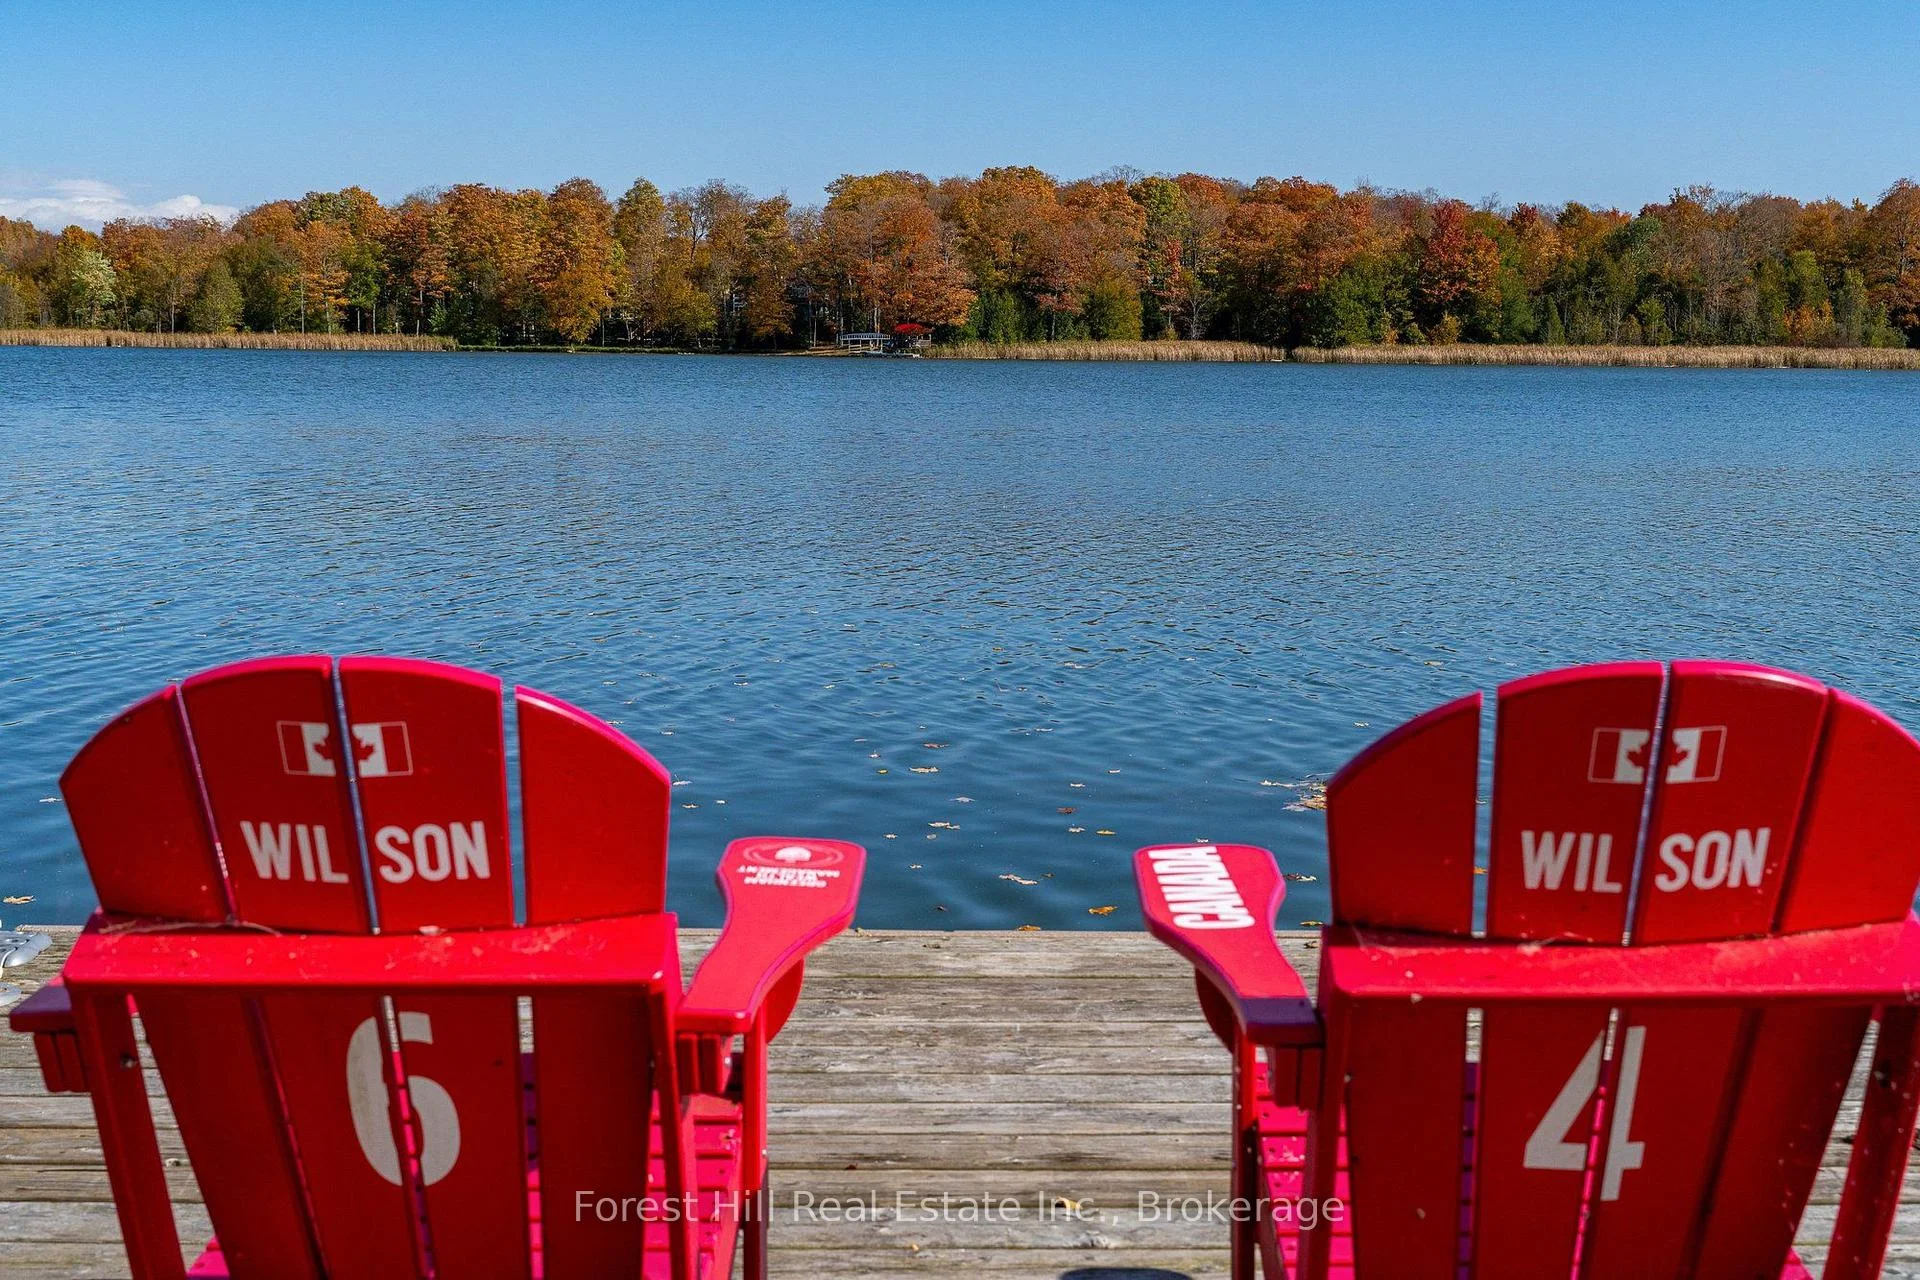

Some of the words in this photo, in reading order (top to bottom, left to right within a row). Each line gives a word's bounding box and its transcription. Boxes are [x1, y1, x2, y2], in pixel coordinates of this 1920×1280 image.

[1148, 846, 1255, 929] CANADA
[346, 1011, 461, 1186] 6
[1523, 1025, 1646, 1201] 4
